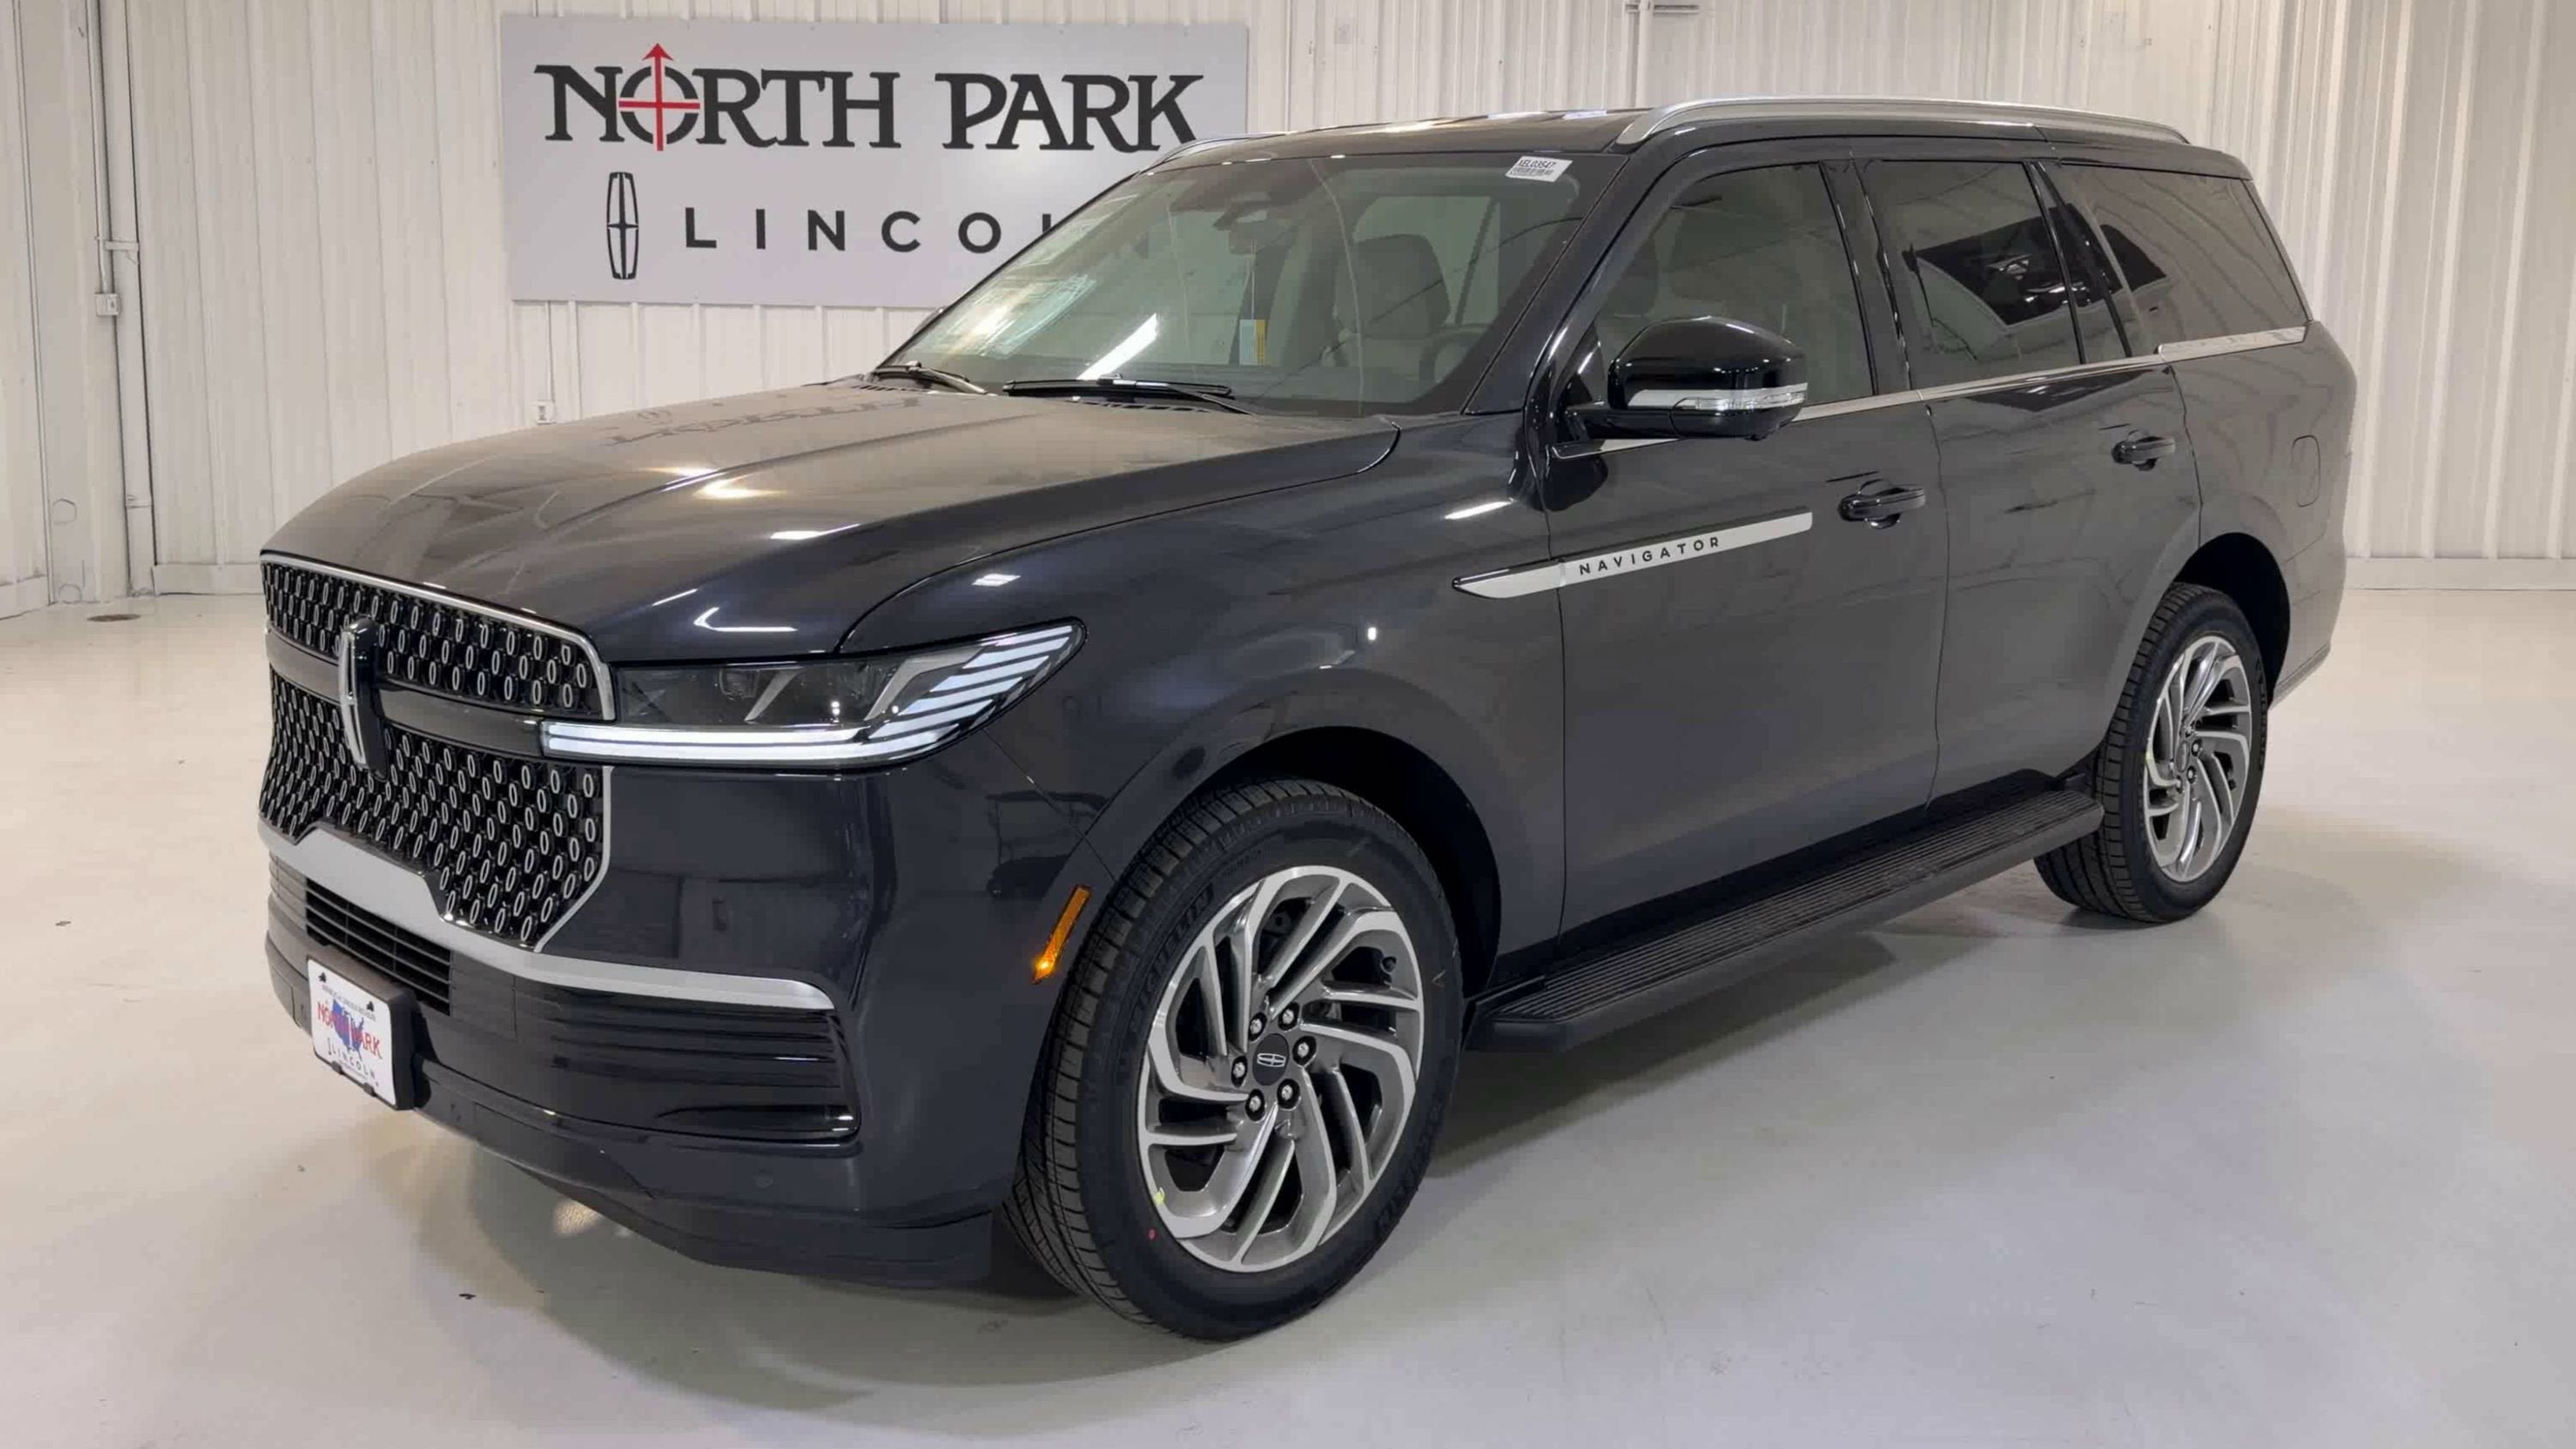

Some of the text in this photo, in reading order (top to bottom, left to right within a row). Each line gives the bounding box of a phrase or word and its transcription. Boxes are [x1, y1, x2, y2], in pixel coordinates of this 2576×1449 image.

[533, 64, 1204, 153] NORTH PARK
[1579, 537, 1718, 574] NAVIGATOR
